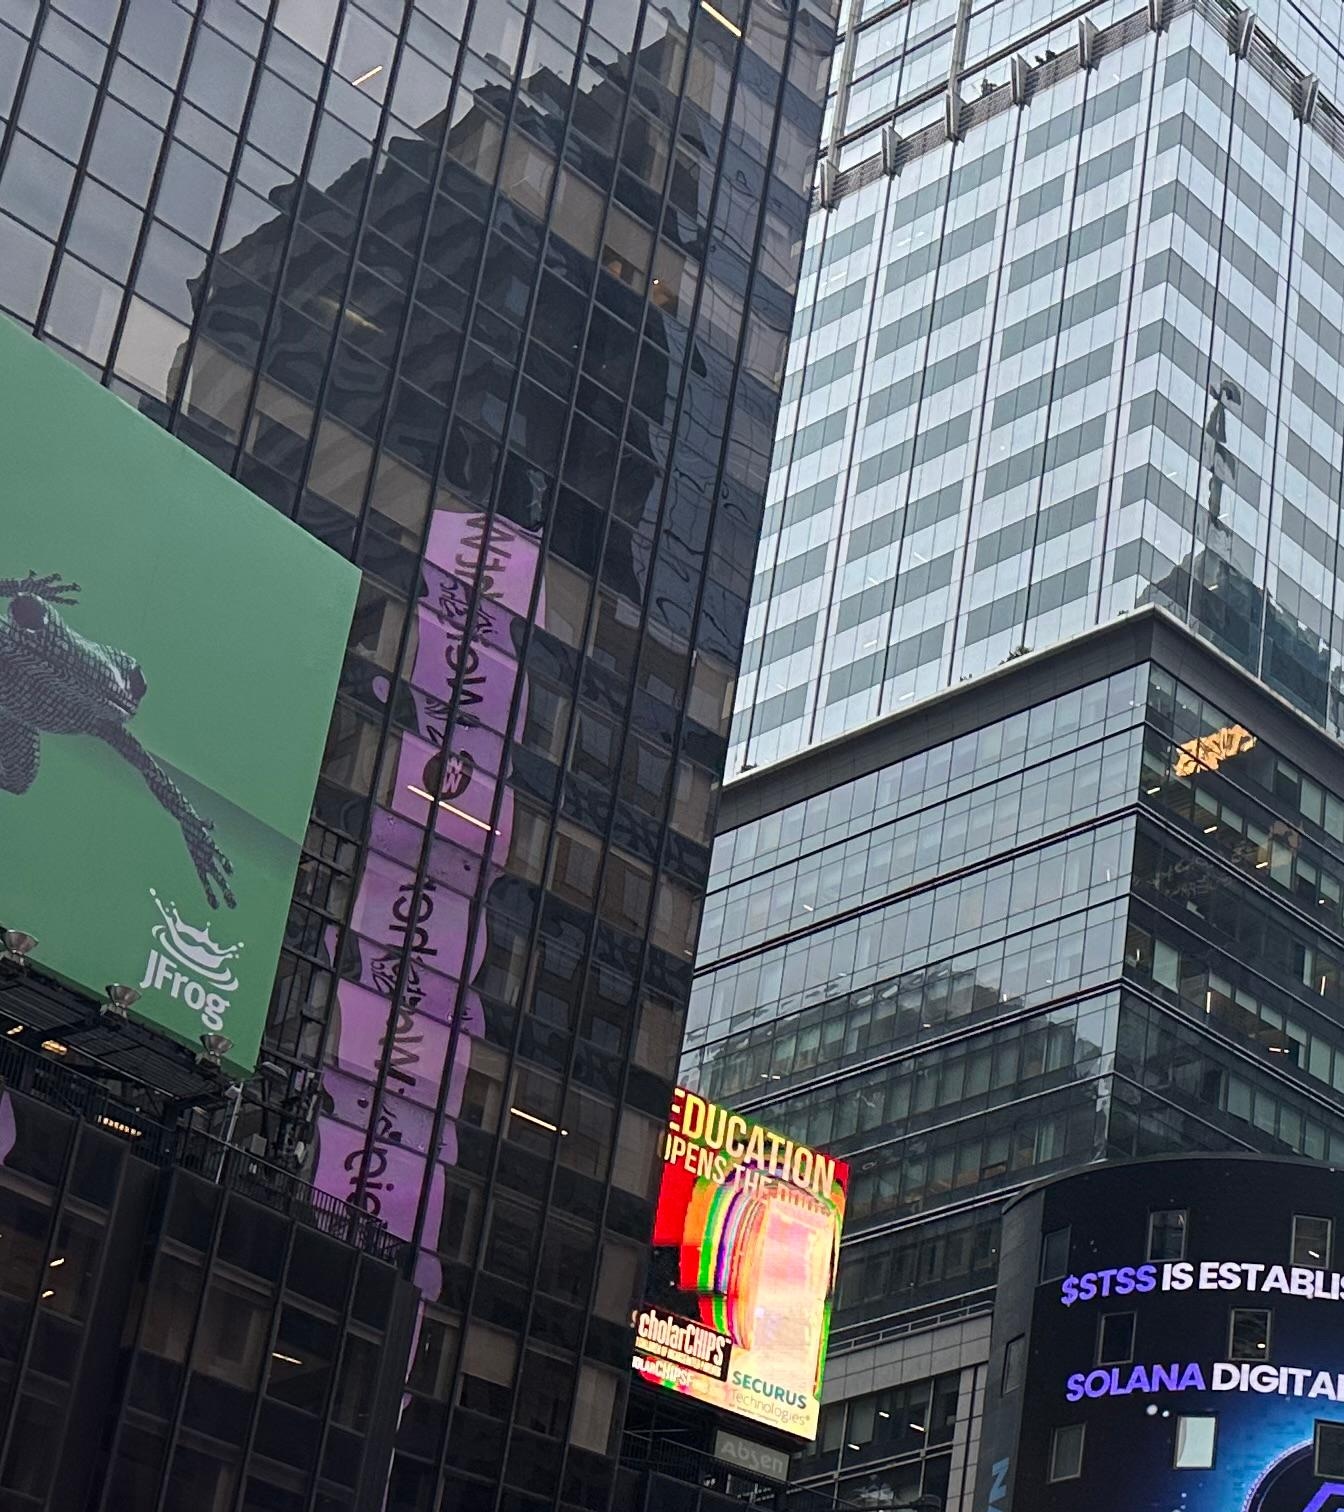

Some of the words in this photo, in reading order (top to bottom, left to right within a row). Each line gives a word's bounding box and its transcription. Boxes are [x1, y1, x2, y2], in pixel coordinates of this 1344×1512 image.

[140, 948, 230, 1031] JFrog
[1060, 1263, 1158, 1308] $STSS
[1161, 1261, 1194, 1291] IS
[732, 1370, 808, 1410] SECURUS
[1065, 1362, 1207, 1402] SOLANA
[721, 1440, 784, 1474] Absen
